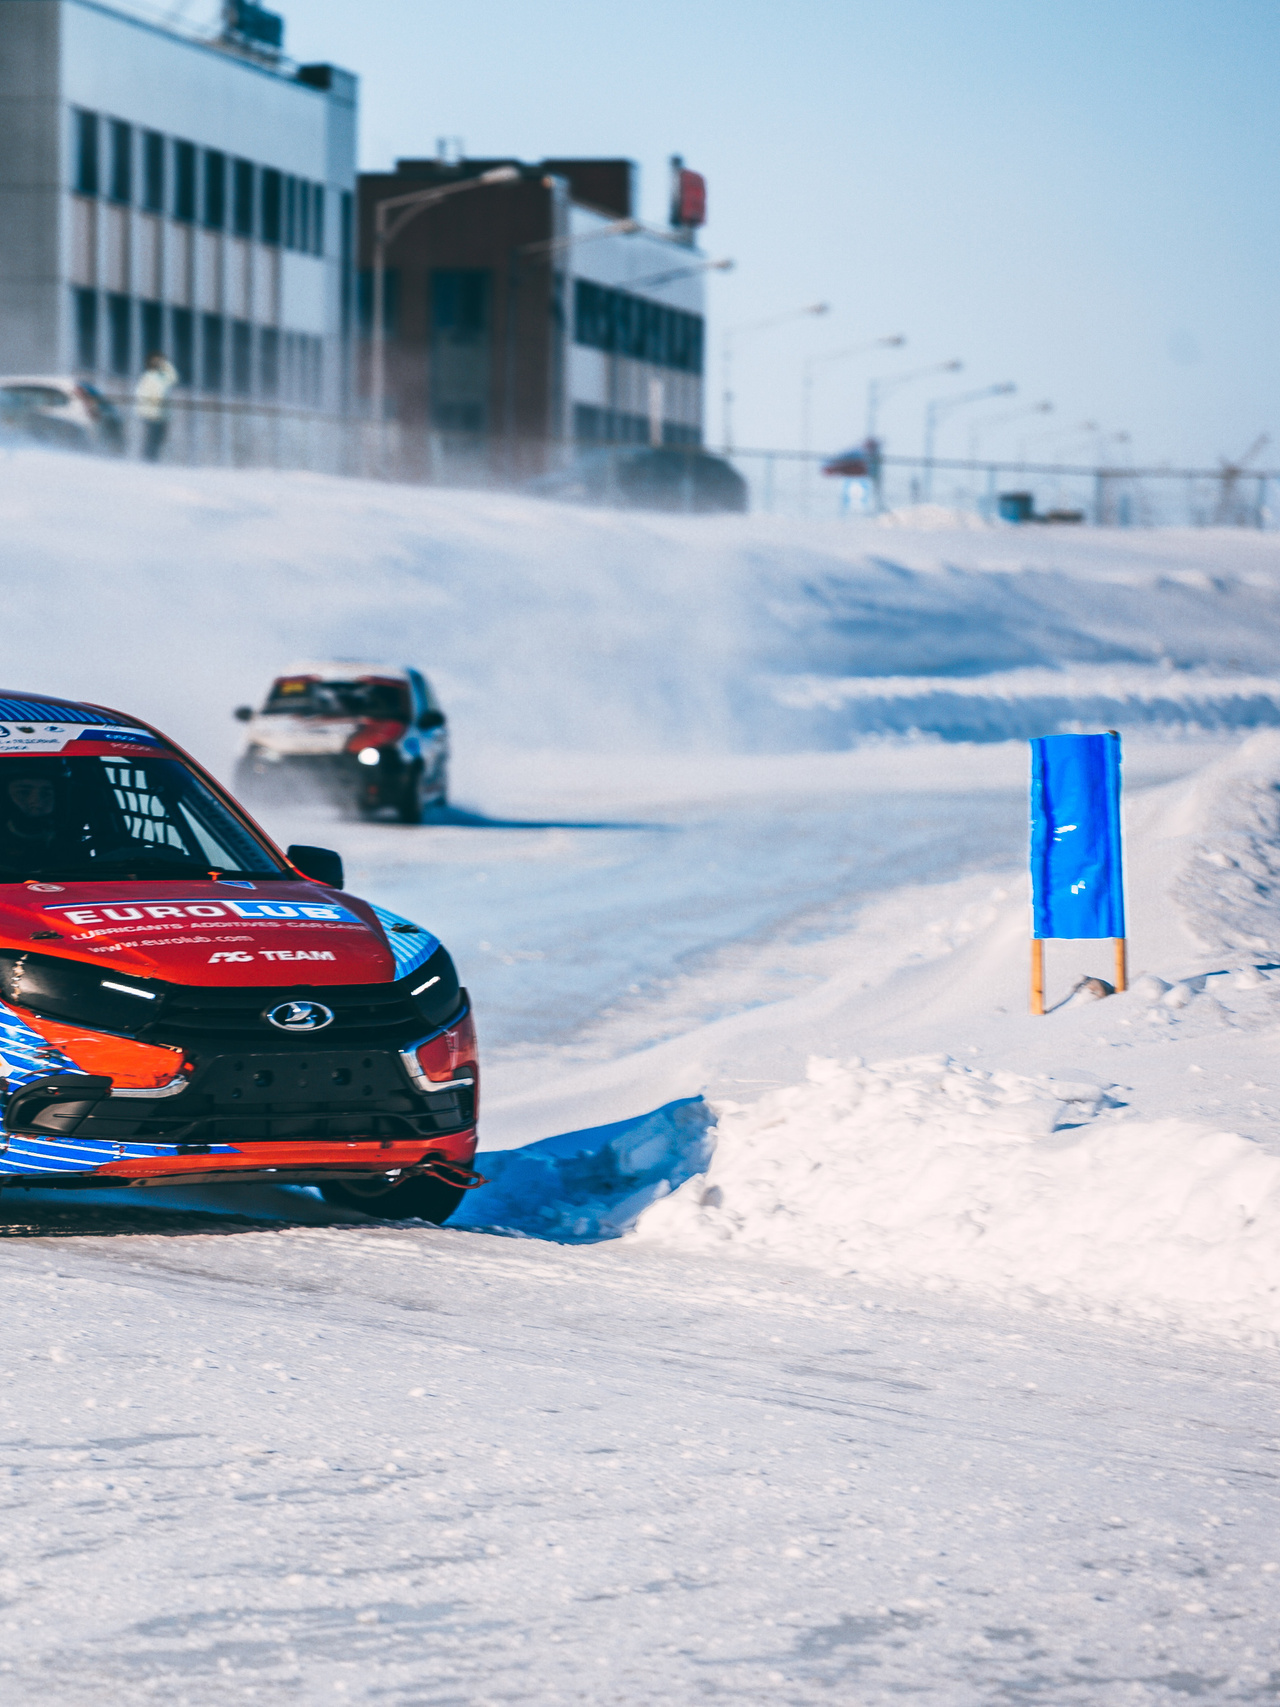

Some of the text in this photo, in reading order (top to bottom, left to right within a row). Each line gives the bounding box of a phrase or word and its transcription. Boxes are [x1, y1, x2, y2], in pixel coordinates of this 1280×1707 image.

[63, 901, 341, 925] EUROLUB
[86, 935, 255, 953] www.eurolub.com
[258, 950, 338, 961] TEAM
